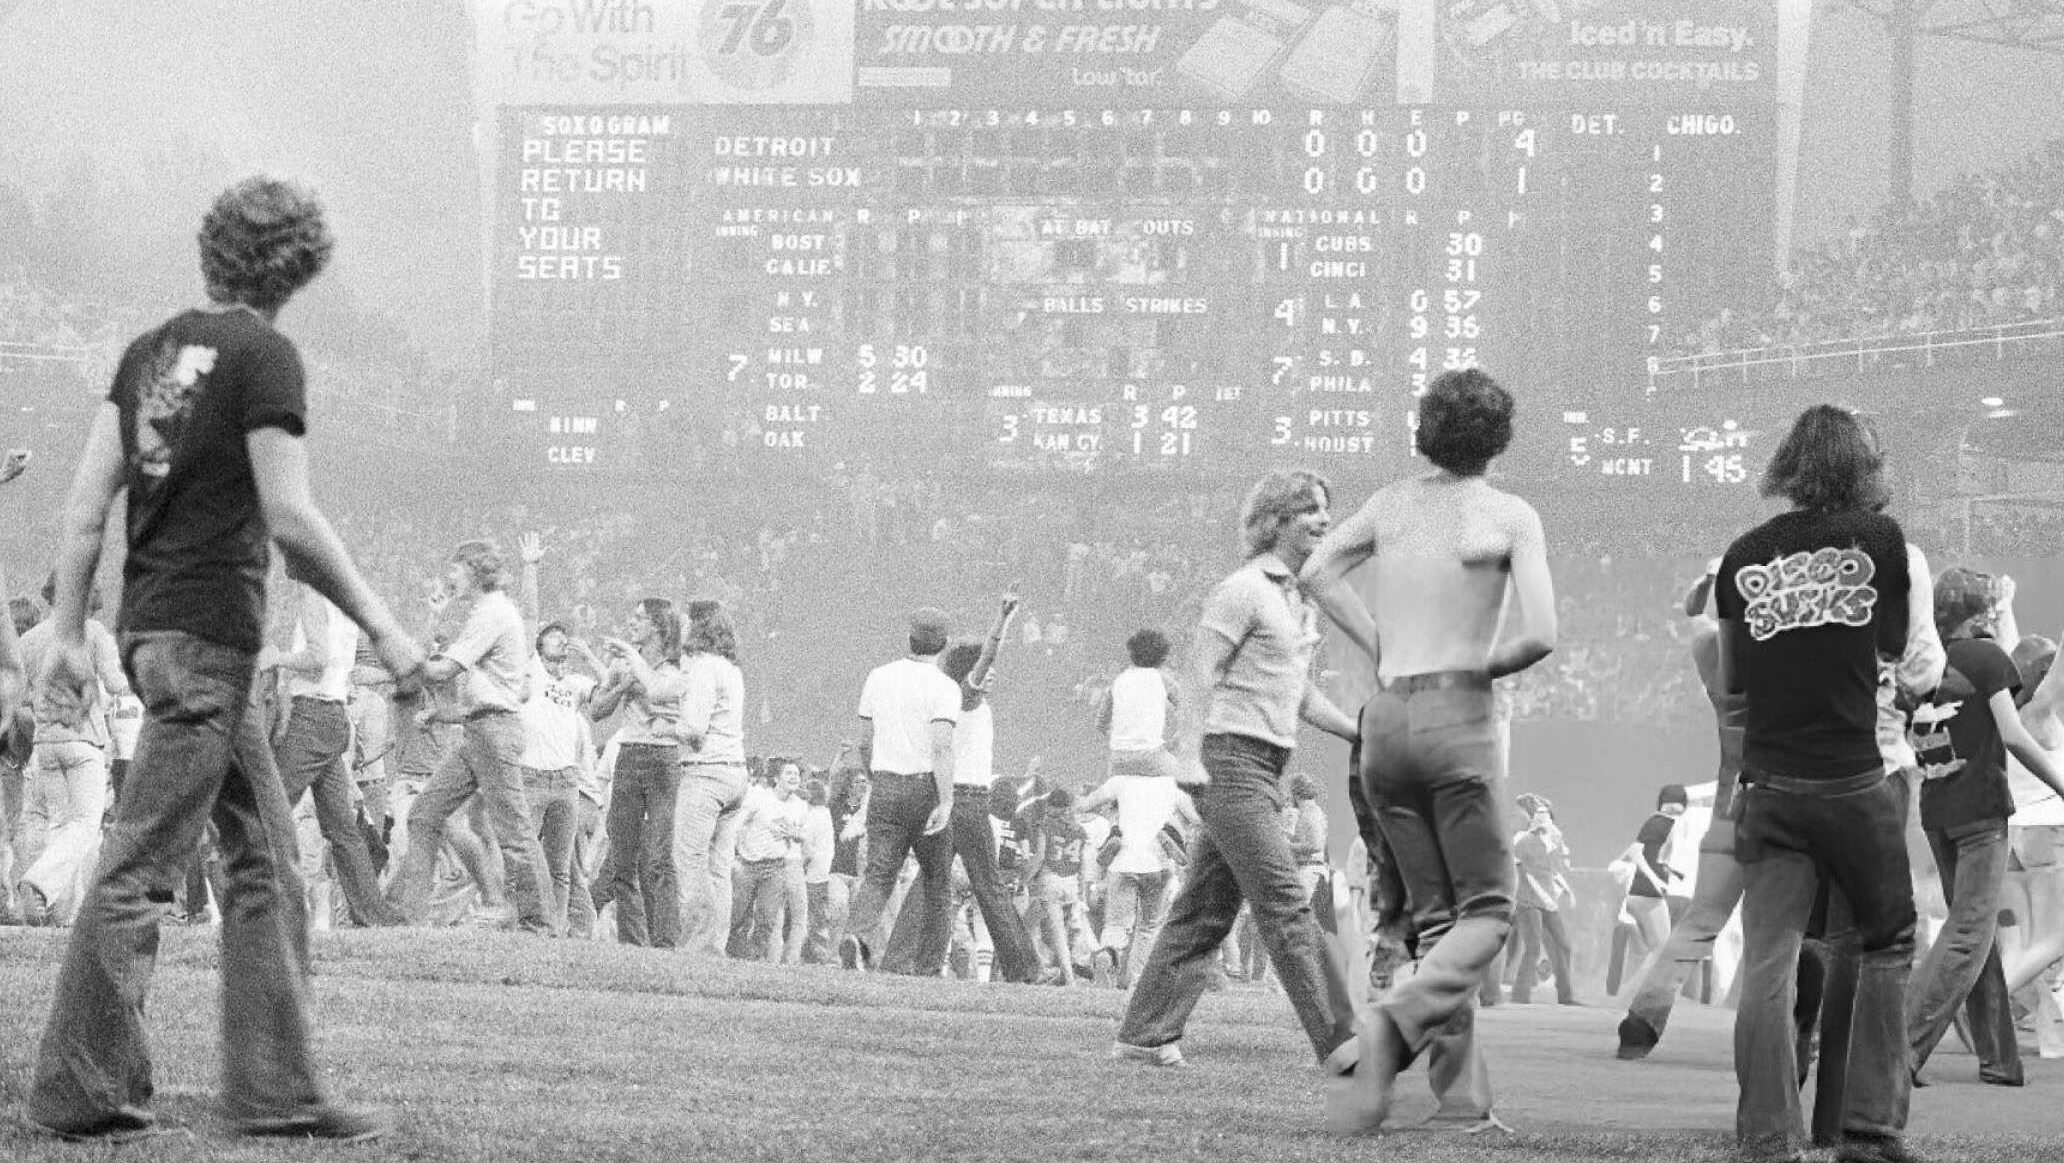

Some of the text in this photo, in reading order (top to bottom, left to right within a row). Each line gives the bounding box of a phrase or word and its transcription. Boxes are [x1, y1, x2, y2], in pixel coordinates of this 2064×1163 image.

[570, 0, 655, 34] With
[718, 0, 794, 56] 76
[1570, 20, 1637, 46] Iced
[1675, 20, 1754, 51] Easy.
[880, 25, 1162, 53] SMOOTH & FRESH
[914, 109, 1272, 126] 1 2 3 4 5 6 7 8 9 10
[1310, 110, 1322, 125] R
[1361, 110, 1374, 125] H
[1411, 110, 1422, 125] E
[1457, 110, 1470, 125] P
[1571, 113, 1625, 134] DET.
[1666, 113, 1742, 135] CHIGO.
[522, 139, 647, 163] PLEASE
[715, 136, 836, 156] DETROIT
[1305, 129, 1535, 158] 0 0 0 4
[1654, 145, 1660, 162] 1
[521, 168, 646, 192] RETURN
[715, 167, 862, 187] WHITE SOX
[1305, 167, 1324, 194] 0
[1406, 167, 1426, 194] 0
[1517, 167, 1526, 194] 1
[1650, 174, 1663, 192] 2
[723, 208, 833, 222] AMERICAN
[857, 209, 869, 223] R
[908, 209, 920, 224] P
[1265, 210, 1381, 224] NATIONAL
[1406, 210, 1418, 225] R
[1458, 210, 1470, 225] P
[1650, 204, 1663, 222] 3
[1042, 219, 1111, 235] AT BAT
[1143, 219, 1194, 236] OUTS
[518, 227, 601, 251] YOUR
[771, 234, 825, 250] BOST
[1315, 235, 1372, 252] CUBS
[1445, 232, 1482, 256] 30
[1649, 234, 1663, 252] 4
[1280, 242, 1288, 271] 1
[517, 256, 624, 280] SEATS
[1309, 261, 1366, 277] CINCI
[1445, 259, 1476, 281] 31
[1649, 264, 1663, 283] 5
[1044, 297, 1105, 313] BALLS
[1125, 297, 1208, 314] STRIKES
[1443, 289, 1481, 313] 57
[1648, 295, 1662, 313] 6
[1274, 299, 1294, 327] 4
[1409, 315, 1480, 339] 9 36
[1647, 325, 1660, 343] 7
[768, 348, 823, 365] MILW
[858, 344, 927, 368] 5 30
[1409, 347, 1427, 370] 4
[727, 354, 748, 382] 7
[1271, 356, 1293, 385] 7
[858, 371, 927, 393] 2 24
[1123, 384, 1136, 400] R
[1172, 384, 1186, 400] P
[1309, 375, 1372, 392] PHILA
[765, 404, 821, 421] BALT
[1034, 408, 1101, 424] TEXAS
[1131, 405, 1198, 429] 3 42
[1309, 409, 1371, 427] PITTS
[1000, 414, 1019, 442] 3
[1271, 416, 1292, 445] 3
[764, 431, 805, 447] OAK
[1132, 430, 1191, 455] 1 21
[1303, 436, 1375, 452] HOUST
[547, 446, 595, 464] CLEV
[1682, 455, 1747, 483] 1 45
